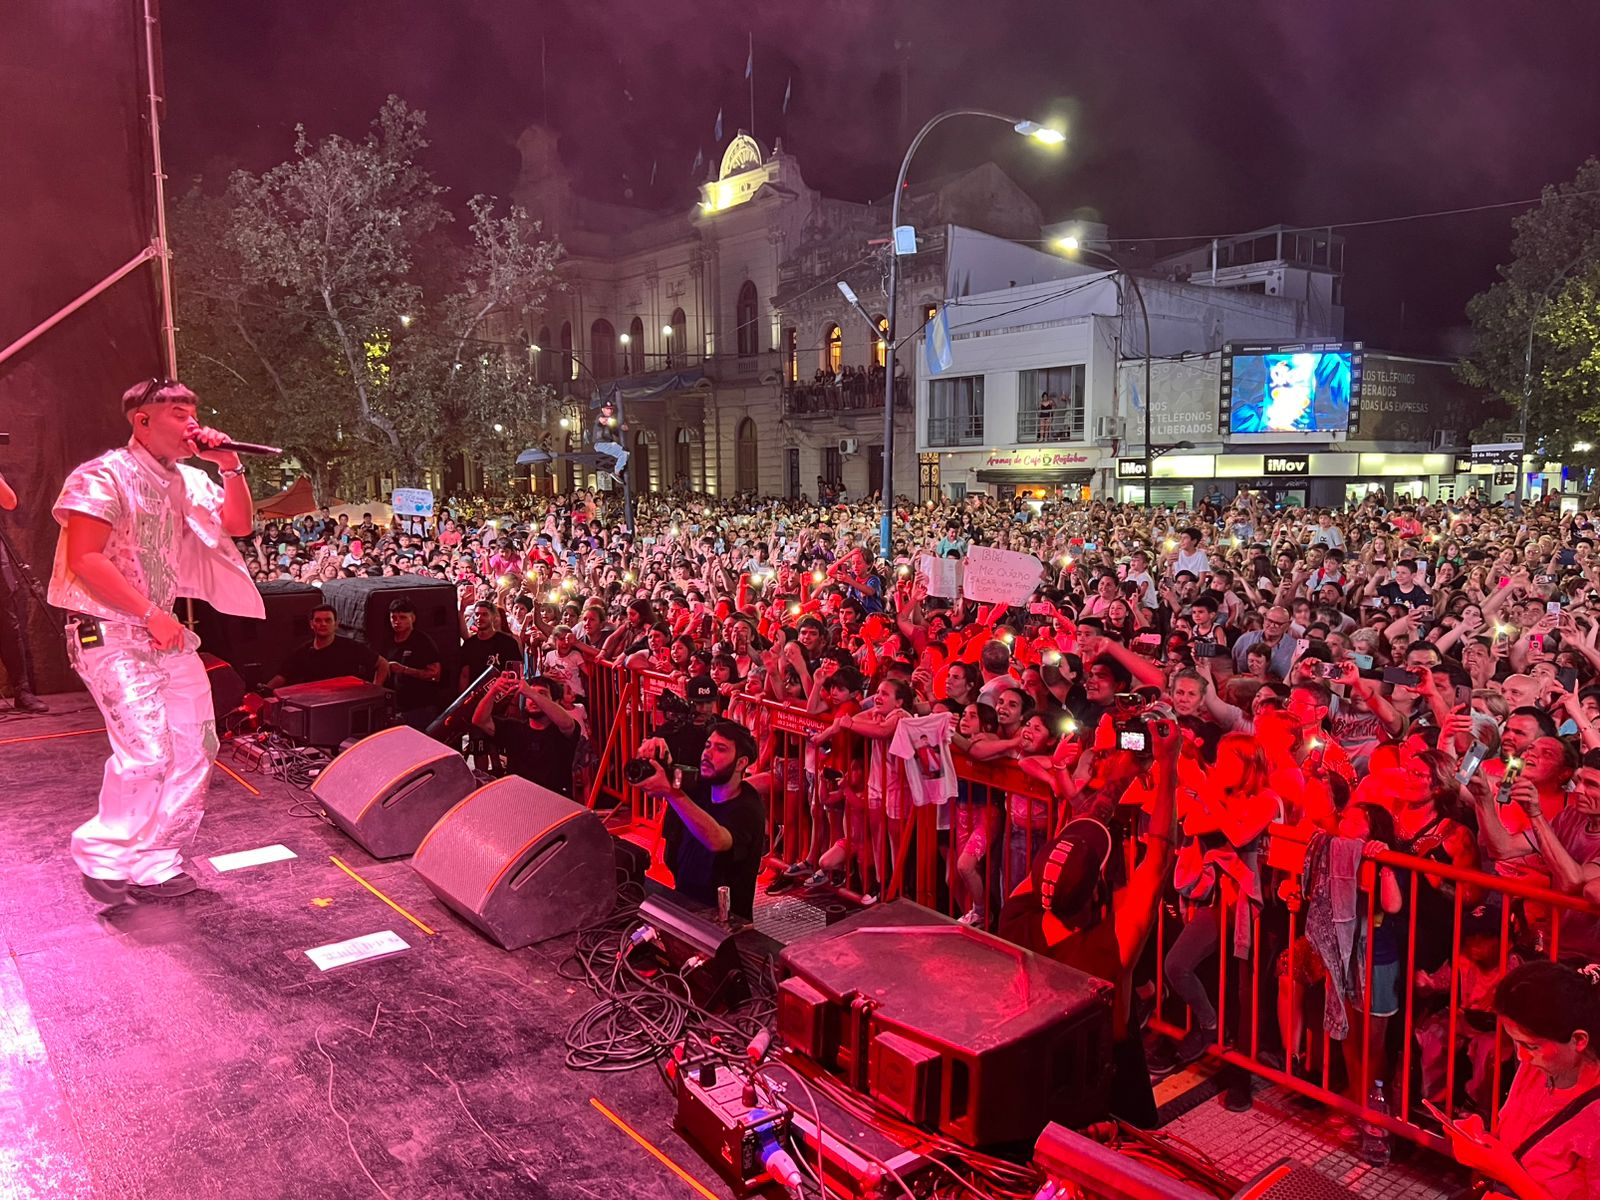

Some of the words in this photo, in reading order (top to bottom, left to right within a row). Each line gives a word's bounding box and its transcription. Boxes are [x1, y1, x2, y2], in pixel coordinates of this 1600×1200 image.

[1362, 370, 1375, 381] LOS
[1361, 384, 1397, 397] BERADOS
[1360, 400, 1379, 411] ODAS
[1380, 401, 1393, 412] LAS
[1394, 401, 1429, 413] EMPRESAS
[1158, 424, 1213, 435] LIBERADOS
[986, 456, 1012, 466] Aromas
[1013, 455, 1022, 464] de
[1267, 458, 1305, 471] iMov
